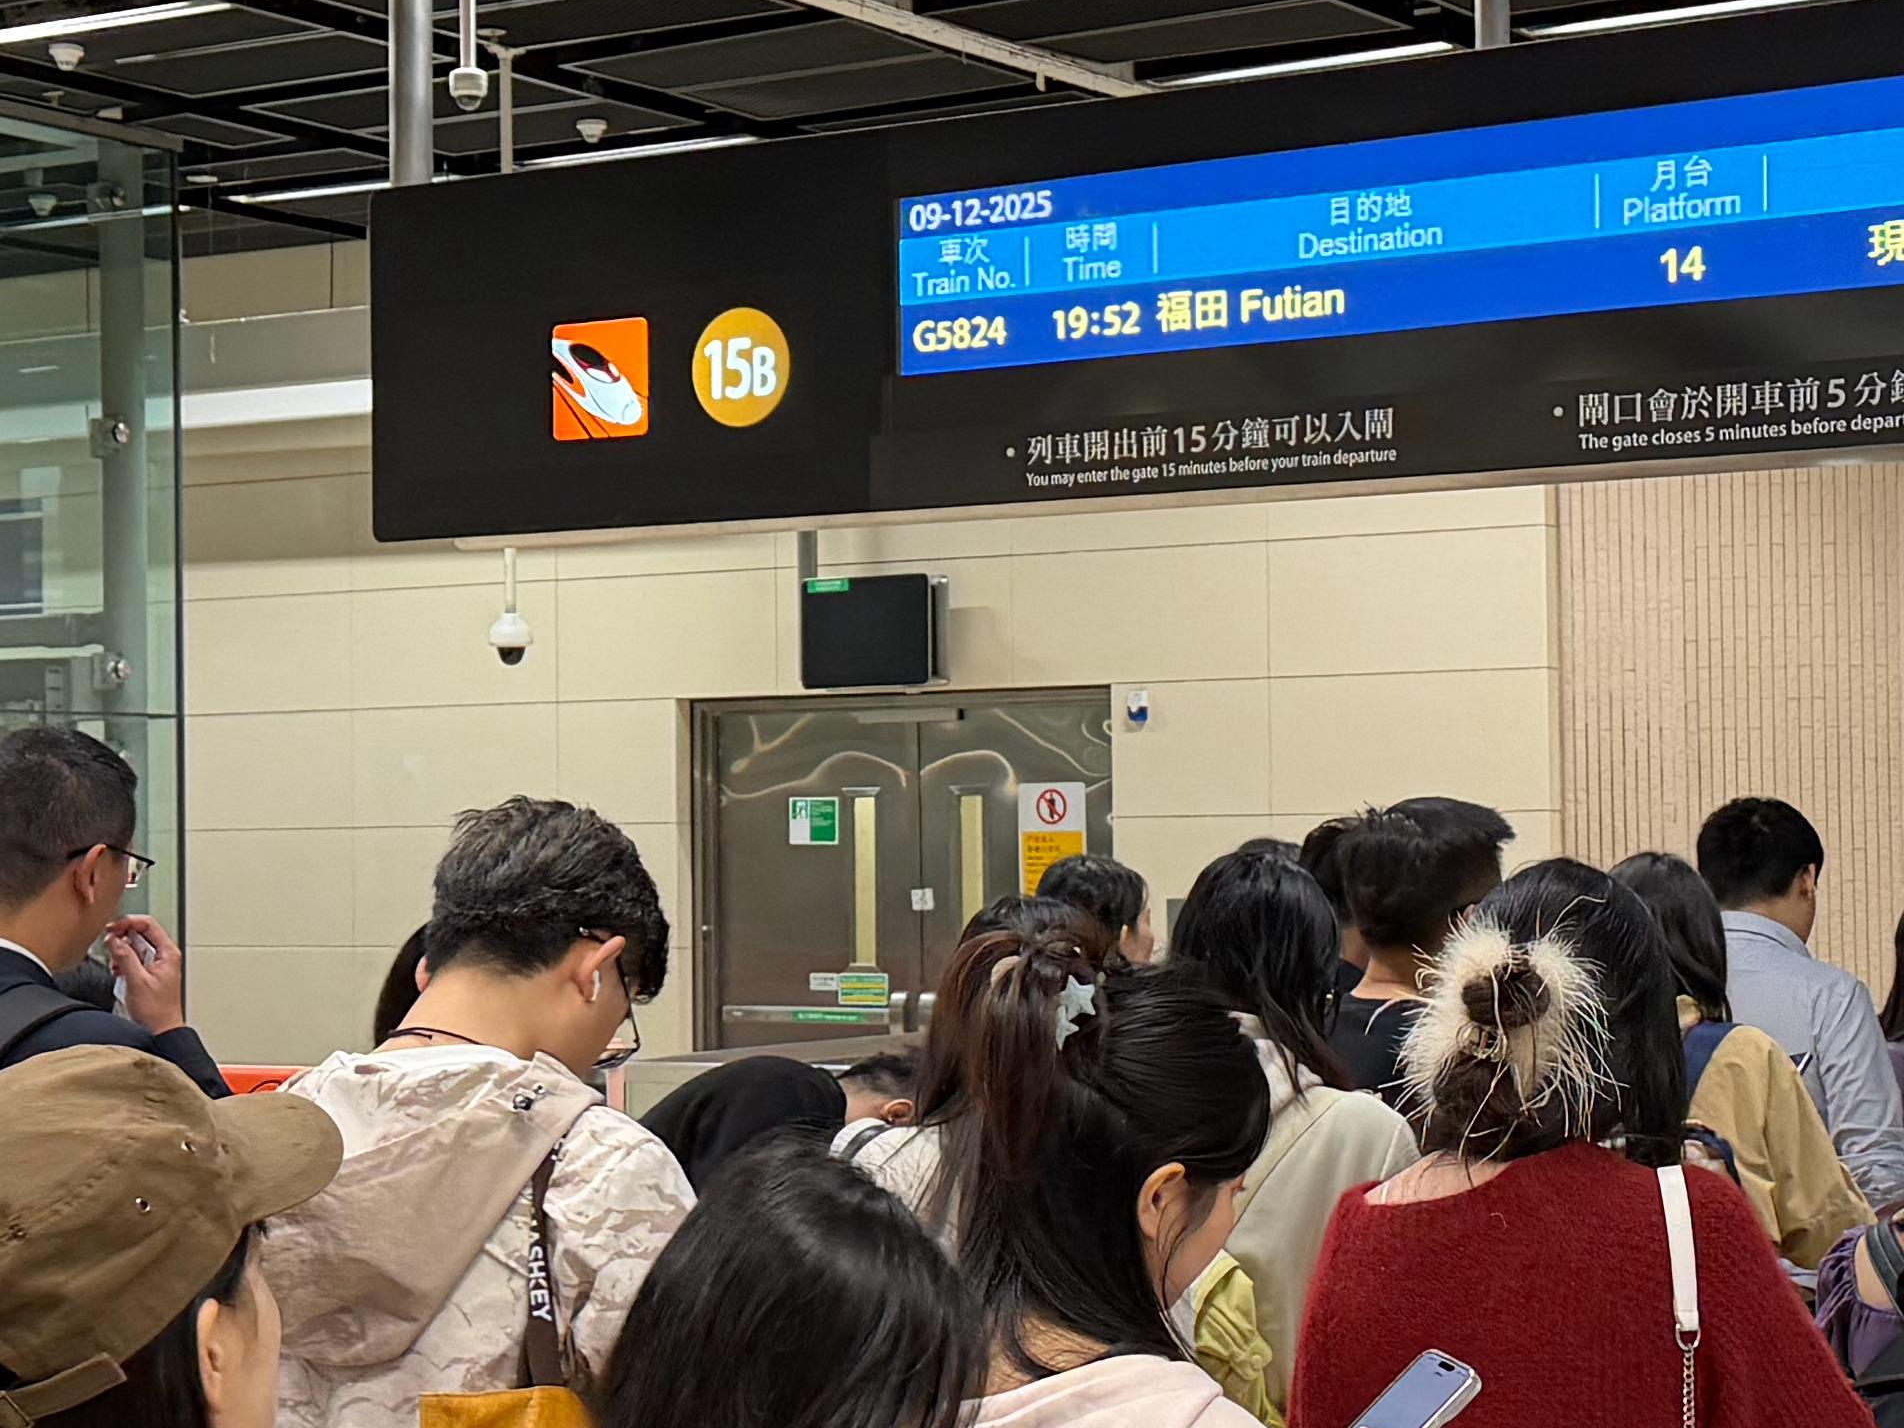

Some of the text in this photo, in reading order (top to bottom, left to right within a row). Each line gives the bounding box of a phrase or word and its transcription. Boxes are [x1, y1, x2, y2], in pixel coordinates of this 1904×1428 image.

[1650, 155, 1713, 192] 月台
[909, 190, 1053, 232] 09-12-2025
[1330, 188, 1413, 226] 目的地
[1623, 193, 1742, 226] Platform
[939, 235, 989, 265] 車次
[1065, 222, 1118, 252] 時間
[1298, 223, 1443, 259] Destination
[912, 266, 1016, 298] Train No.
[1063, 256, 1122, 282] Time
[1660, 245, 1706, 283] 14
[1052, 301, 1142, 341] 19:52
[1156, 285, 1345, 333] 福田 Futian
[912, 315, 1007, 352] G5824
[703, 335, 776, 400] 15B
[1578, 433, 1608, 450] The
[1612, 432, 1648, 451] gate
[1651, 428, 1701, 446] closes
[1704, 426, 1715, 442] 5
[1718, 422, 1786, 441] minutes
[1790, 416, 1846, 435] before
[1026, 448, 1397, 487] You may enter the gate 15 minutes before your train departure
[528, 1217, 553, 1322] ASHKEY
